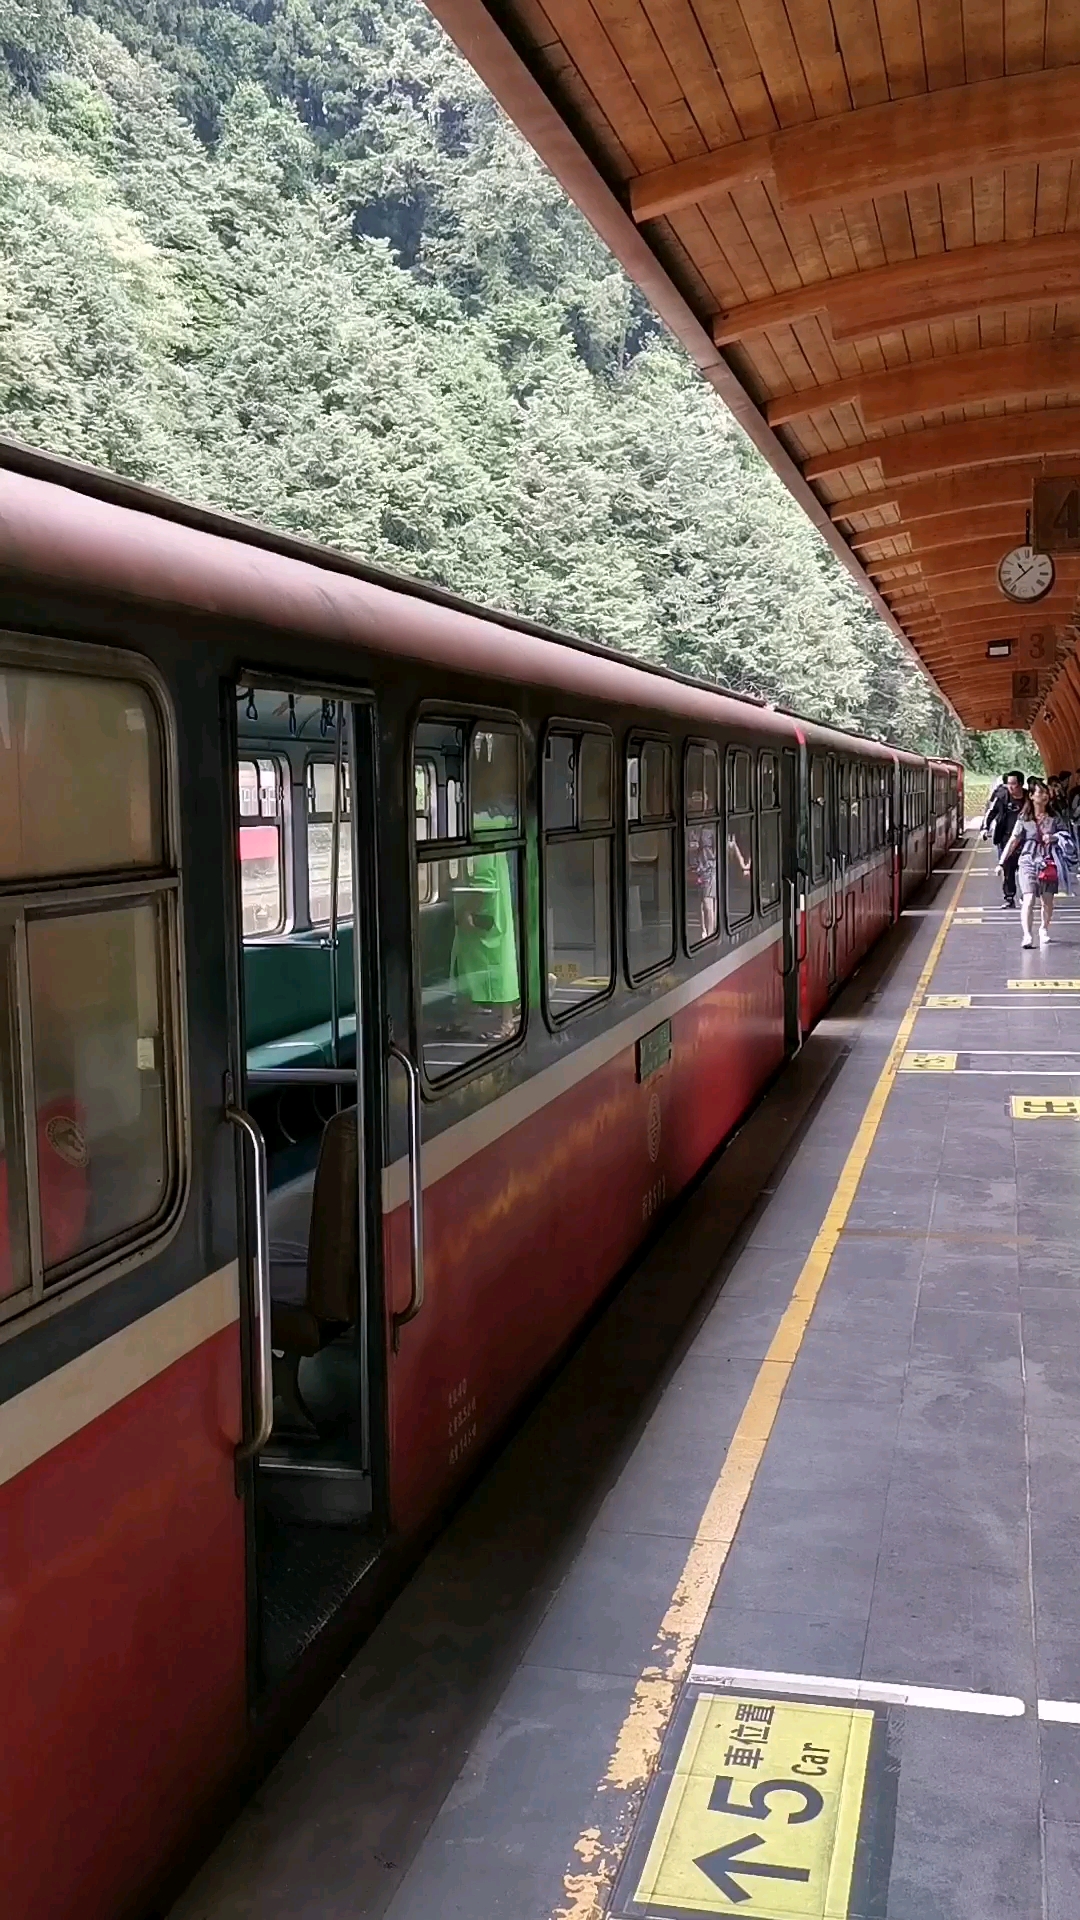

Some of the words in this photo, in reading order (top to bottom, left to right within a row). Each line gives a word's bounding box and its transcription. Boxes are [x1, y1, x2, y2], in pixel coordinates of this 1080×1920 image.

[1053, 489, 1080, 538] 4
[1029, 633, 1046, 659] 3
[1019, 676, 1031, 694] 2
[724, 1704, 776, 1769] 車位置
[791, 1742, 831, 1776] Car
[708, 1774, 825, 1825] 5
